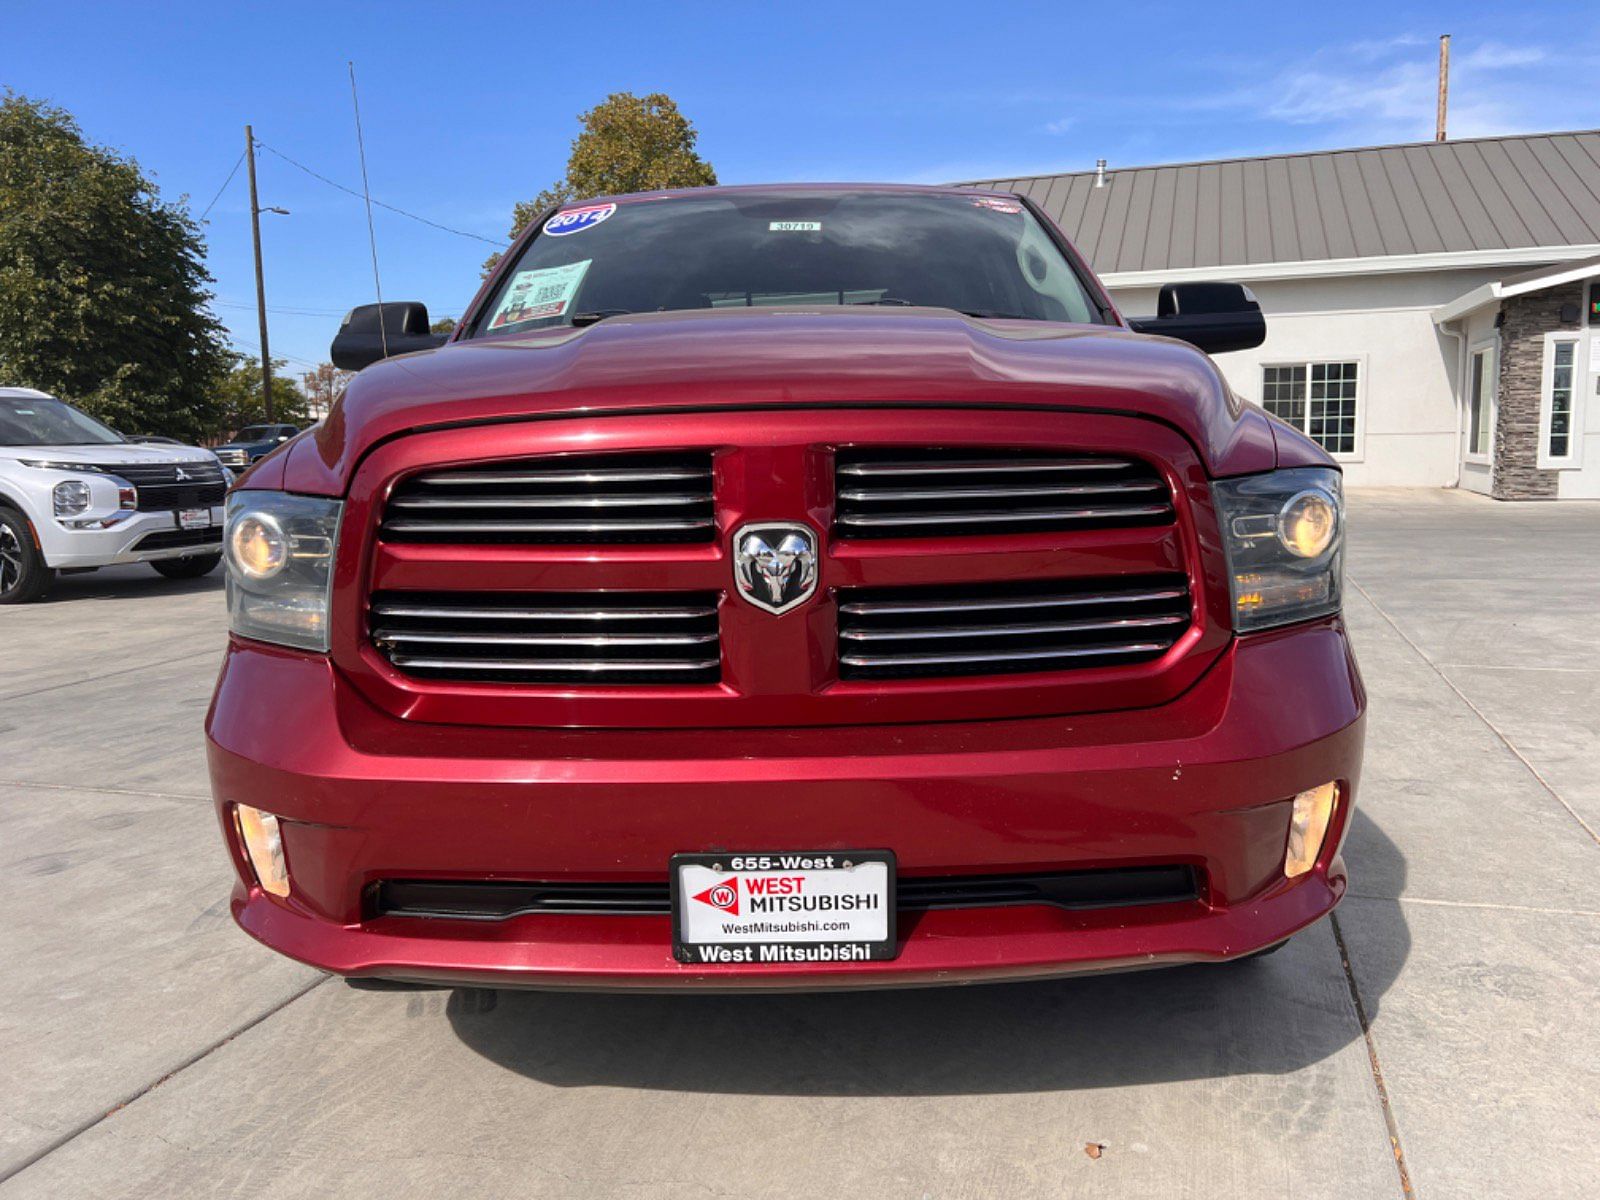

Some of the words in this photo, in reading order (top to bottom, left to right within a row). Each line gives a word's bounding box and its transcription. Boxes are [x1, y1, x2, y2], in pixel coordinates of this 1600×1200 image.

[731, 856, 835, 871] 655-West
[745, 877, 806, 895] WEST
[715, 890, 730, 902] W
[750, 894, 879, 913] MITSUBISHI
[721, 920, 851, 935] WestMitsubishi.com
[698, 946, 753, 963] West
[759, 943, 871, 962] Mitsubishi
